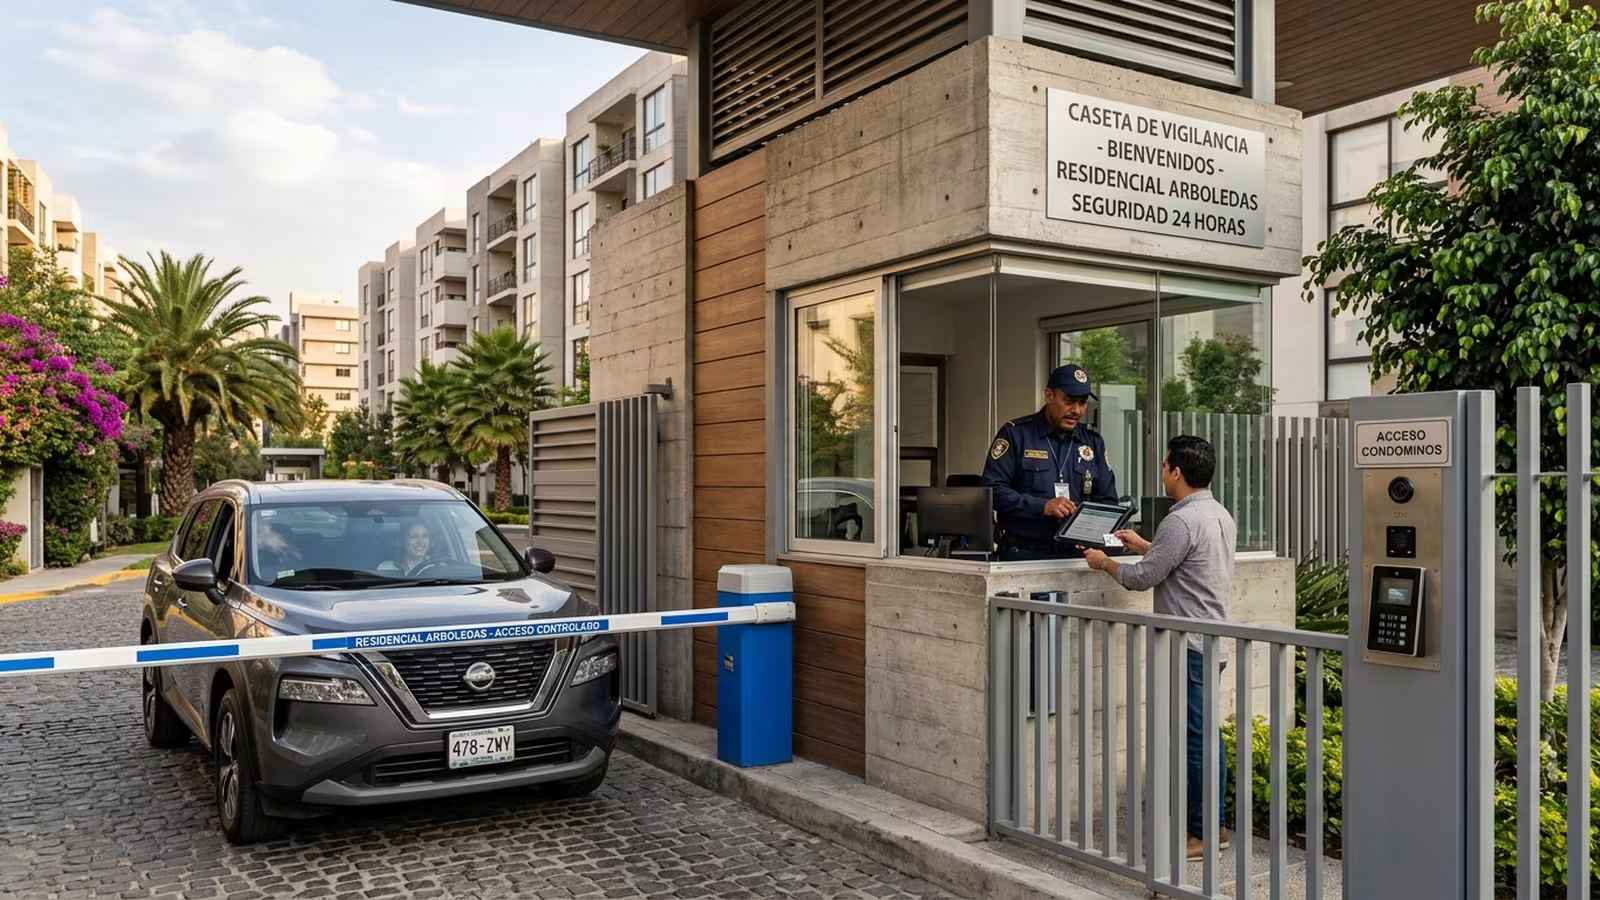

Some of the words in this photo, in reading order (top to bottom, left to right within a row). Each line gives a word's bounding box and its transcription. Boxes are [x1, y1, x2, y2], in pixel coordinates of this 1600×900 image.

[1068, 103, 1133, 132] CASETA
[1137, 116, 1158, 137] DE
[1161, 120, 1249, 155] VIGILANCIA
[1107, 139, 1215, 176] BIENVENIDOS
[1056, 160, 1165, 196] RESIDENCIAL
[1169, 180, 1258, 211] ARBOLEDAS
[1072, 193, 1168, 225] SEGURIDAD
[1172, 209, 1191, 228] 24
[1194, 212, 1246, 236] HORAS
[1361, 444, 1443, 457] CONDOMINOS
[1376, 429, 1426, 442] ACCESO
[355, 633, 424, 648] RESIDENCIAL
[494, 625, 535, 638] ACCESO
